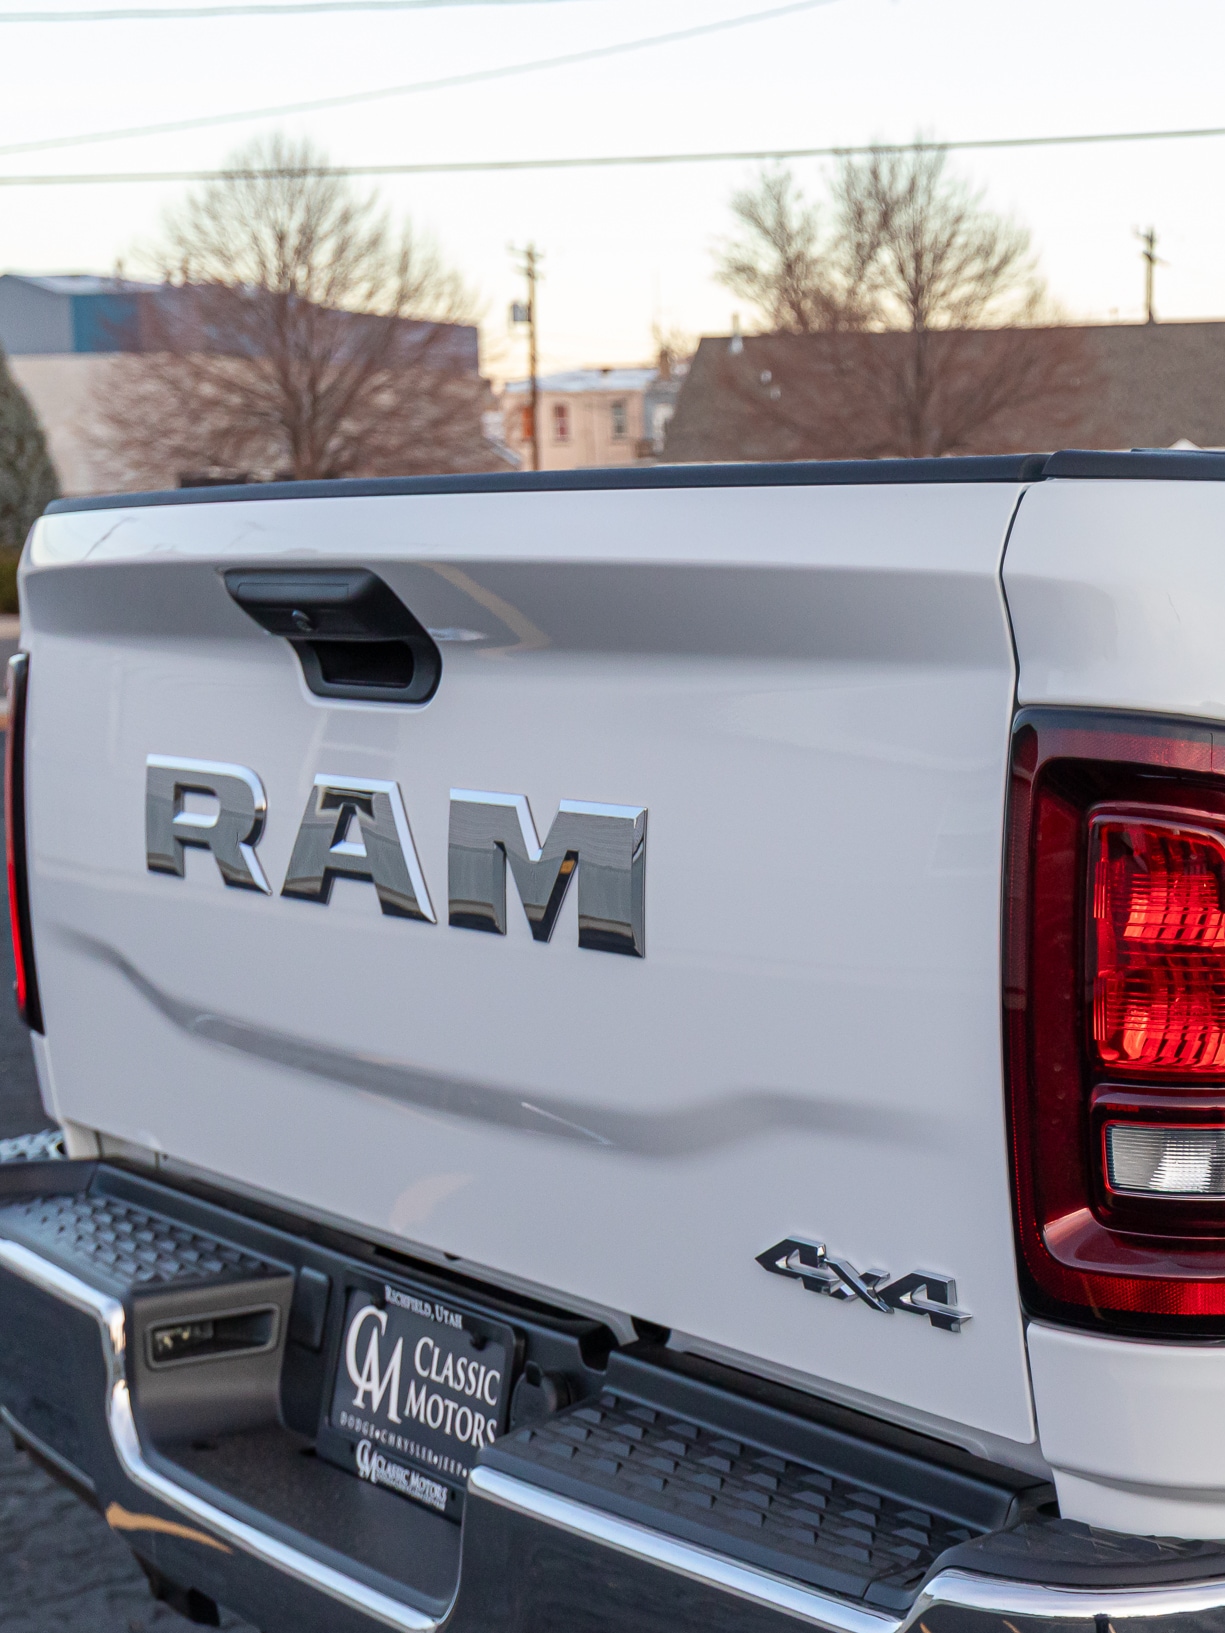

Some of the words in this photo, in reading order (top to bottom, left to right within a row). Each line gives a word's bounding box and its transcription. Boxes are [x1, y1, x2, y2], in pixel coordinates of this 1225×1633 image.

[145, 753, 648, 958] RAM
[434, 1303, 463, 1330] UTAH
[414, 1336, 501, 1406] CLASSIC
[403, 1379, 498, 1449] MOTORS
